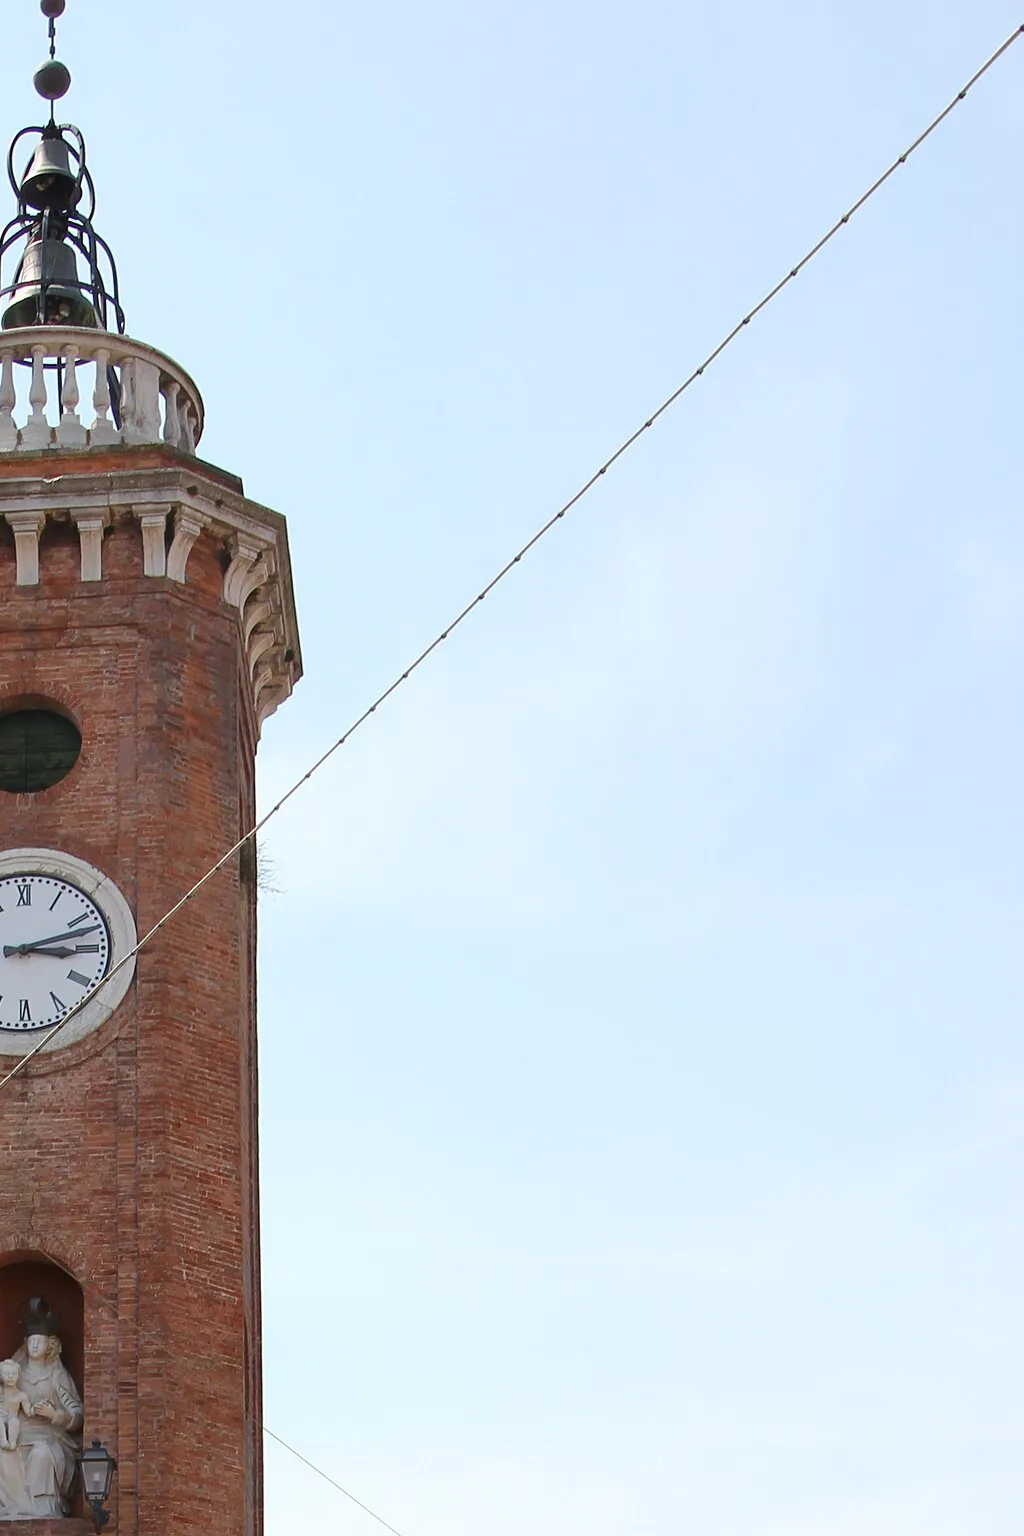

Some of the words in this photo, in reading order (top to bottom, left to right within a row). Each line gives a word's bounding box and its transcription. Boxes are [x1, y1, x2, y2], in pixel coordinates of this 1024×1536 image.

[17, 884, 32, 906] XII
[49, 891, 63, 911] I
[67, 912, 90, 928] II
[75, 943, 99, 954] III
[19, 999, 32, 1021] VI
[49, 991, 65, 1013] V
